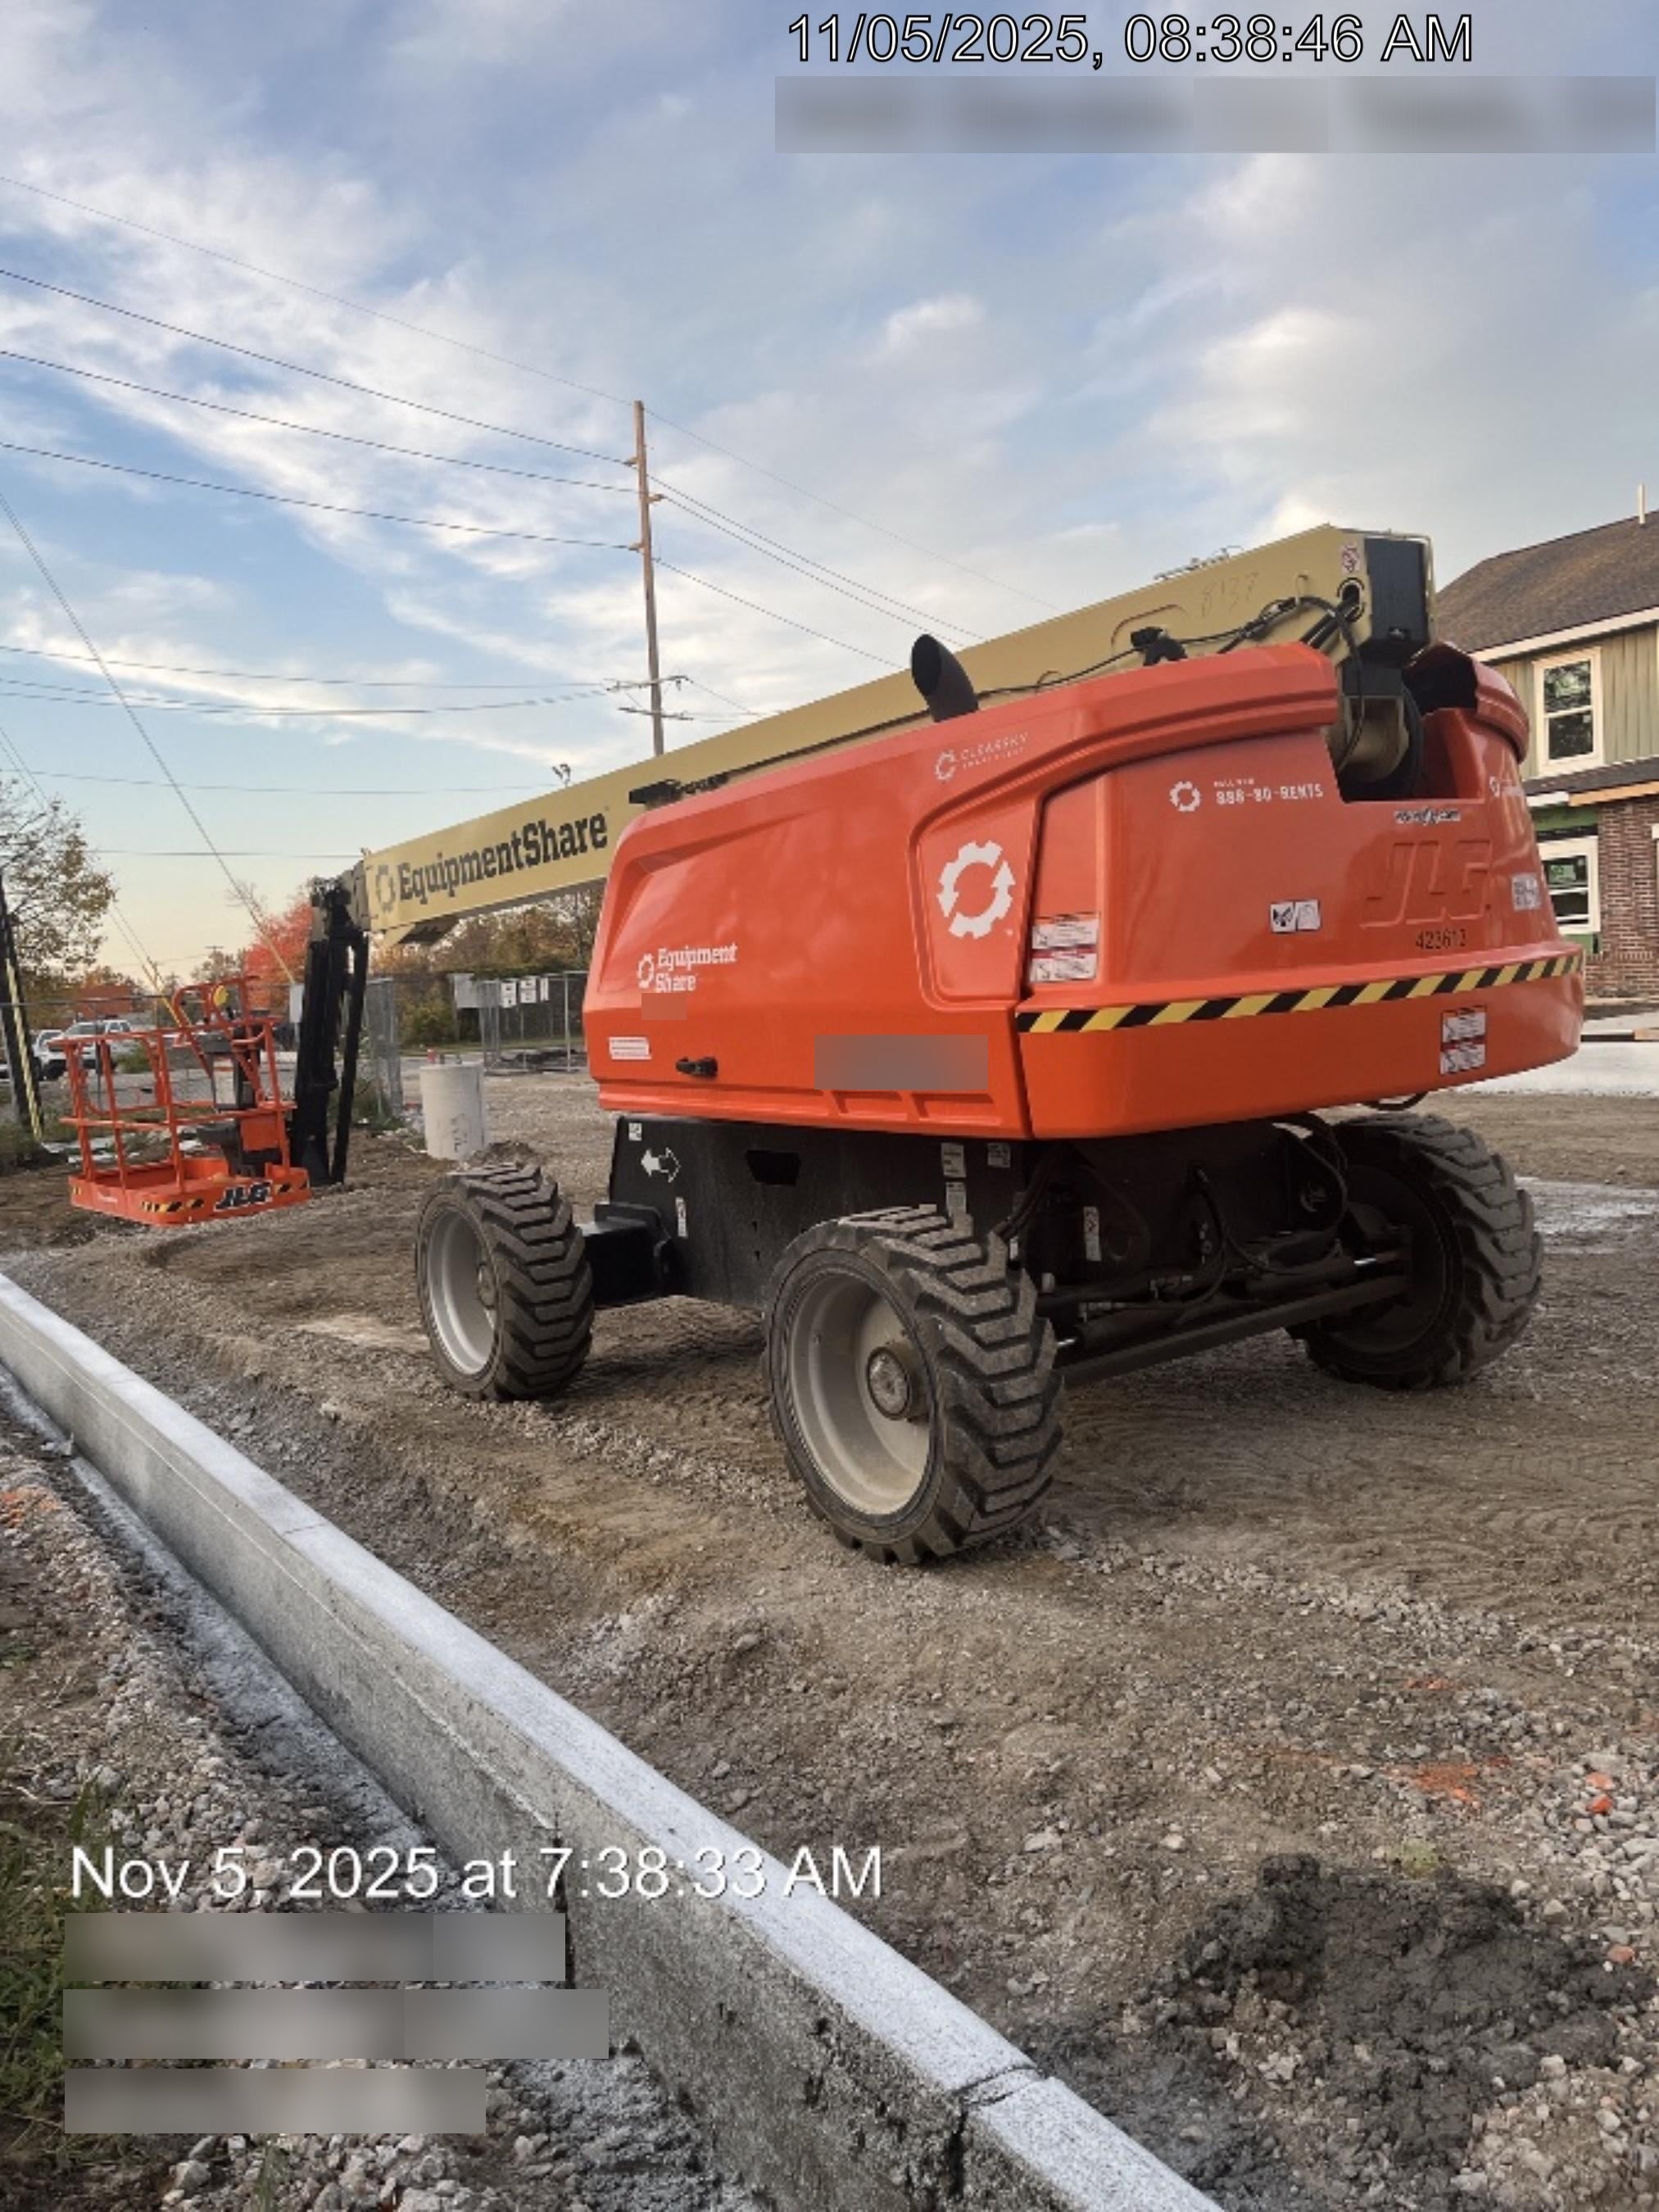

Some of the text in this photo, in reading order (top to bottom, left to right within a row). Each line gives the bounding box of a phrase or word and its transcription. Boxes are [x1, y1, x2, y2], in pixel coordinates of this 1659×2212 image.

[398, 813, 608, 904] EquipmentShare
[1360, 839, 1493, 928] JLG
[658, 941, 737, 972] Equipment
[655, 972, 696, 993] Share
[214, 1181, 273, 1211] JLG
